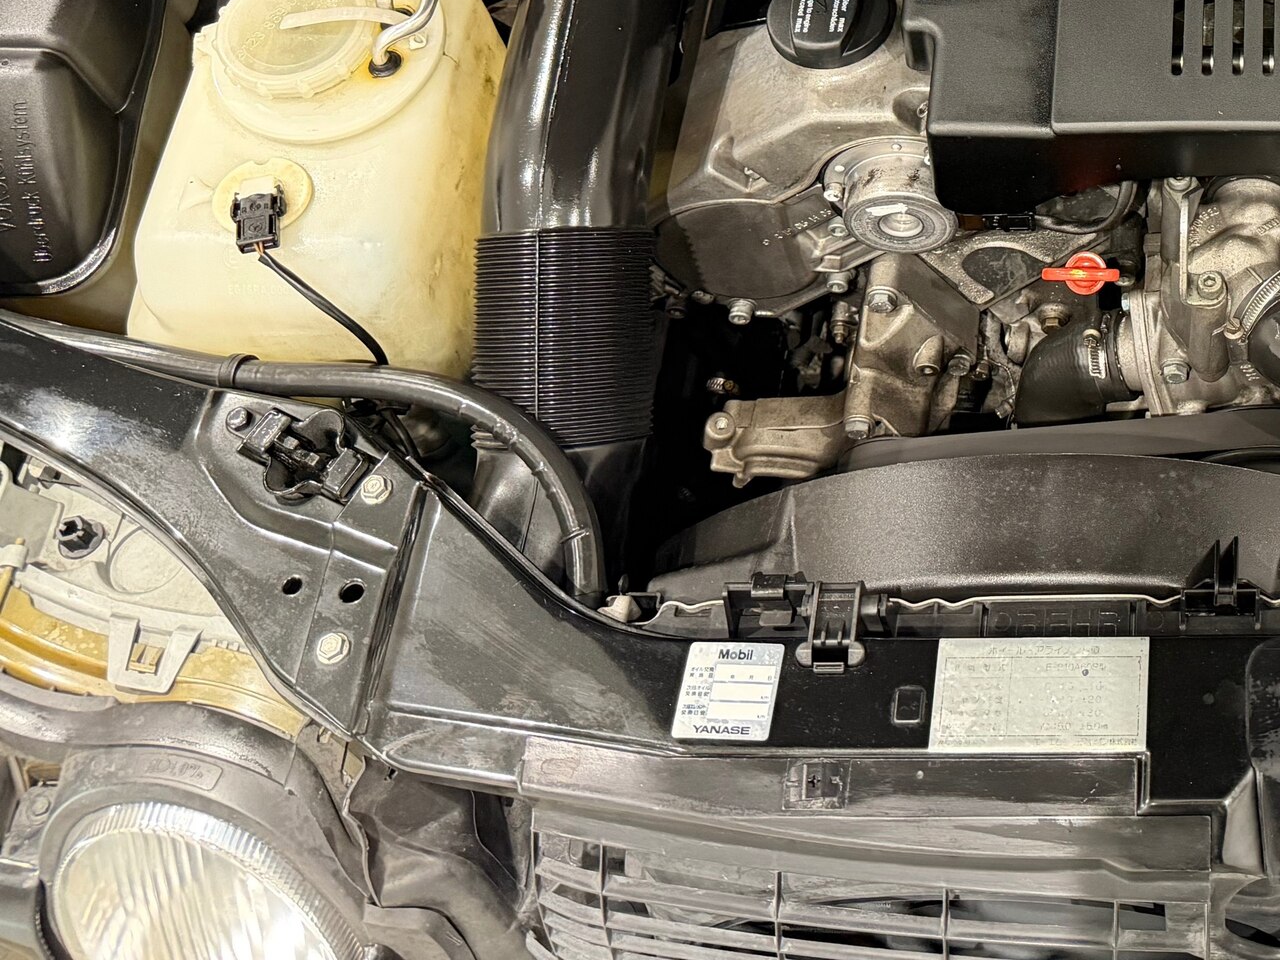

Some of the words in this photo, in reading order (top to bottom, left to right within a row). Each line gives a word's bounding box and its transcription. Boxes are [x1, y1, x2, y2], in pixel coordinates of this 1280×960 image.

[794, 17, 803, 33] max
[837, 17, 846, 33] max
[11, 99, 37, 185] Kühlsystem
[718, 649, 754, 661] Mobil
[693, 724, 751, 735] YANASE
